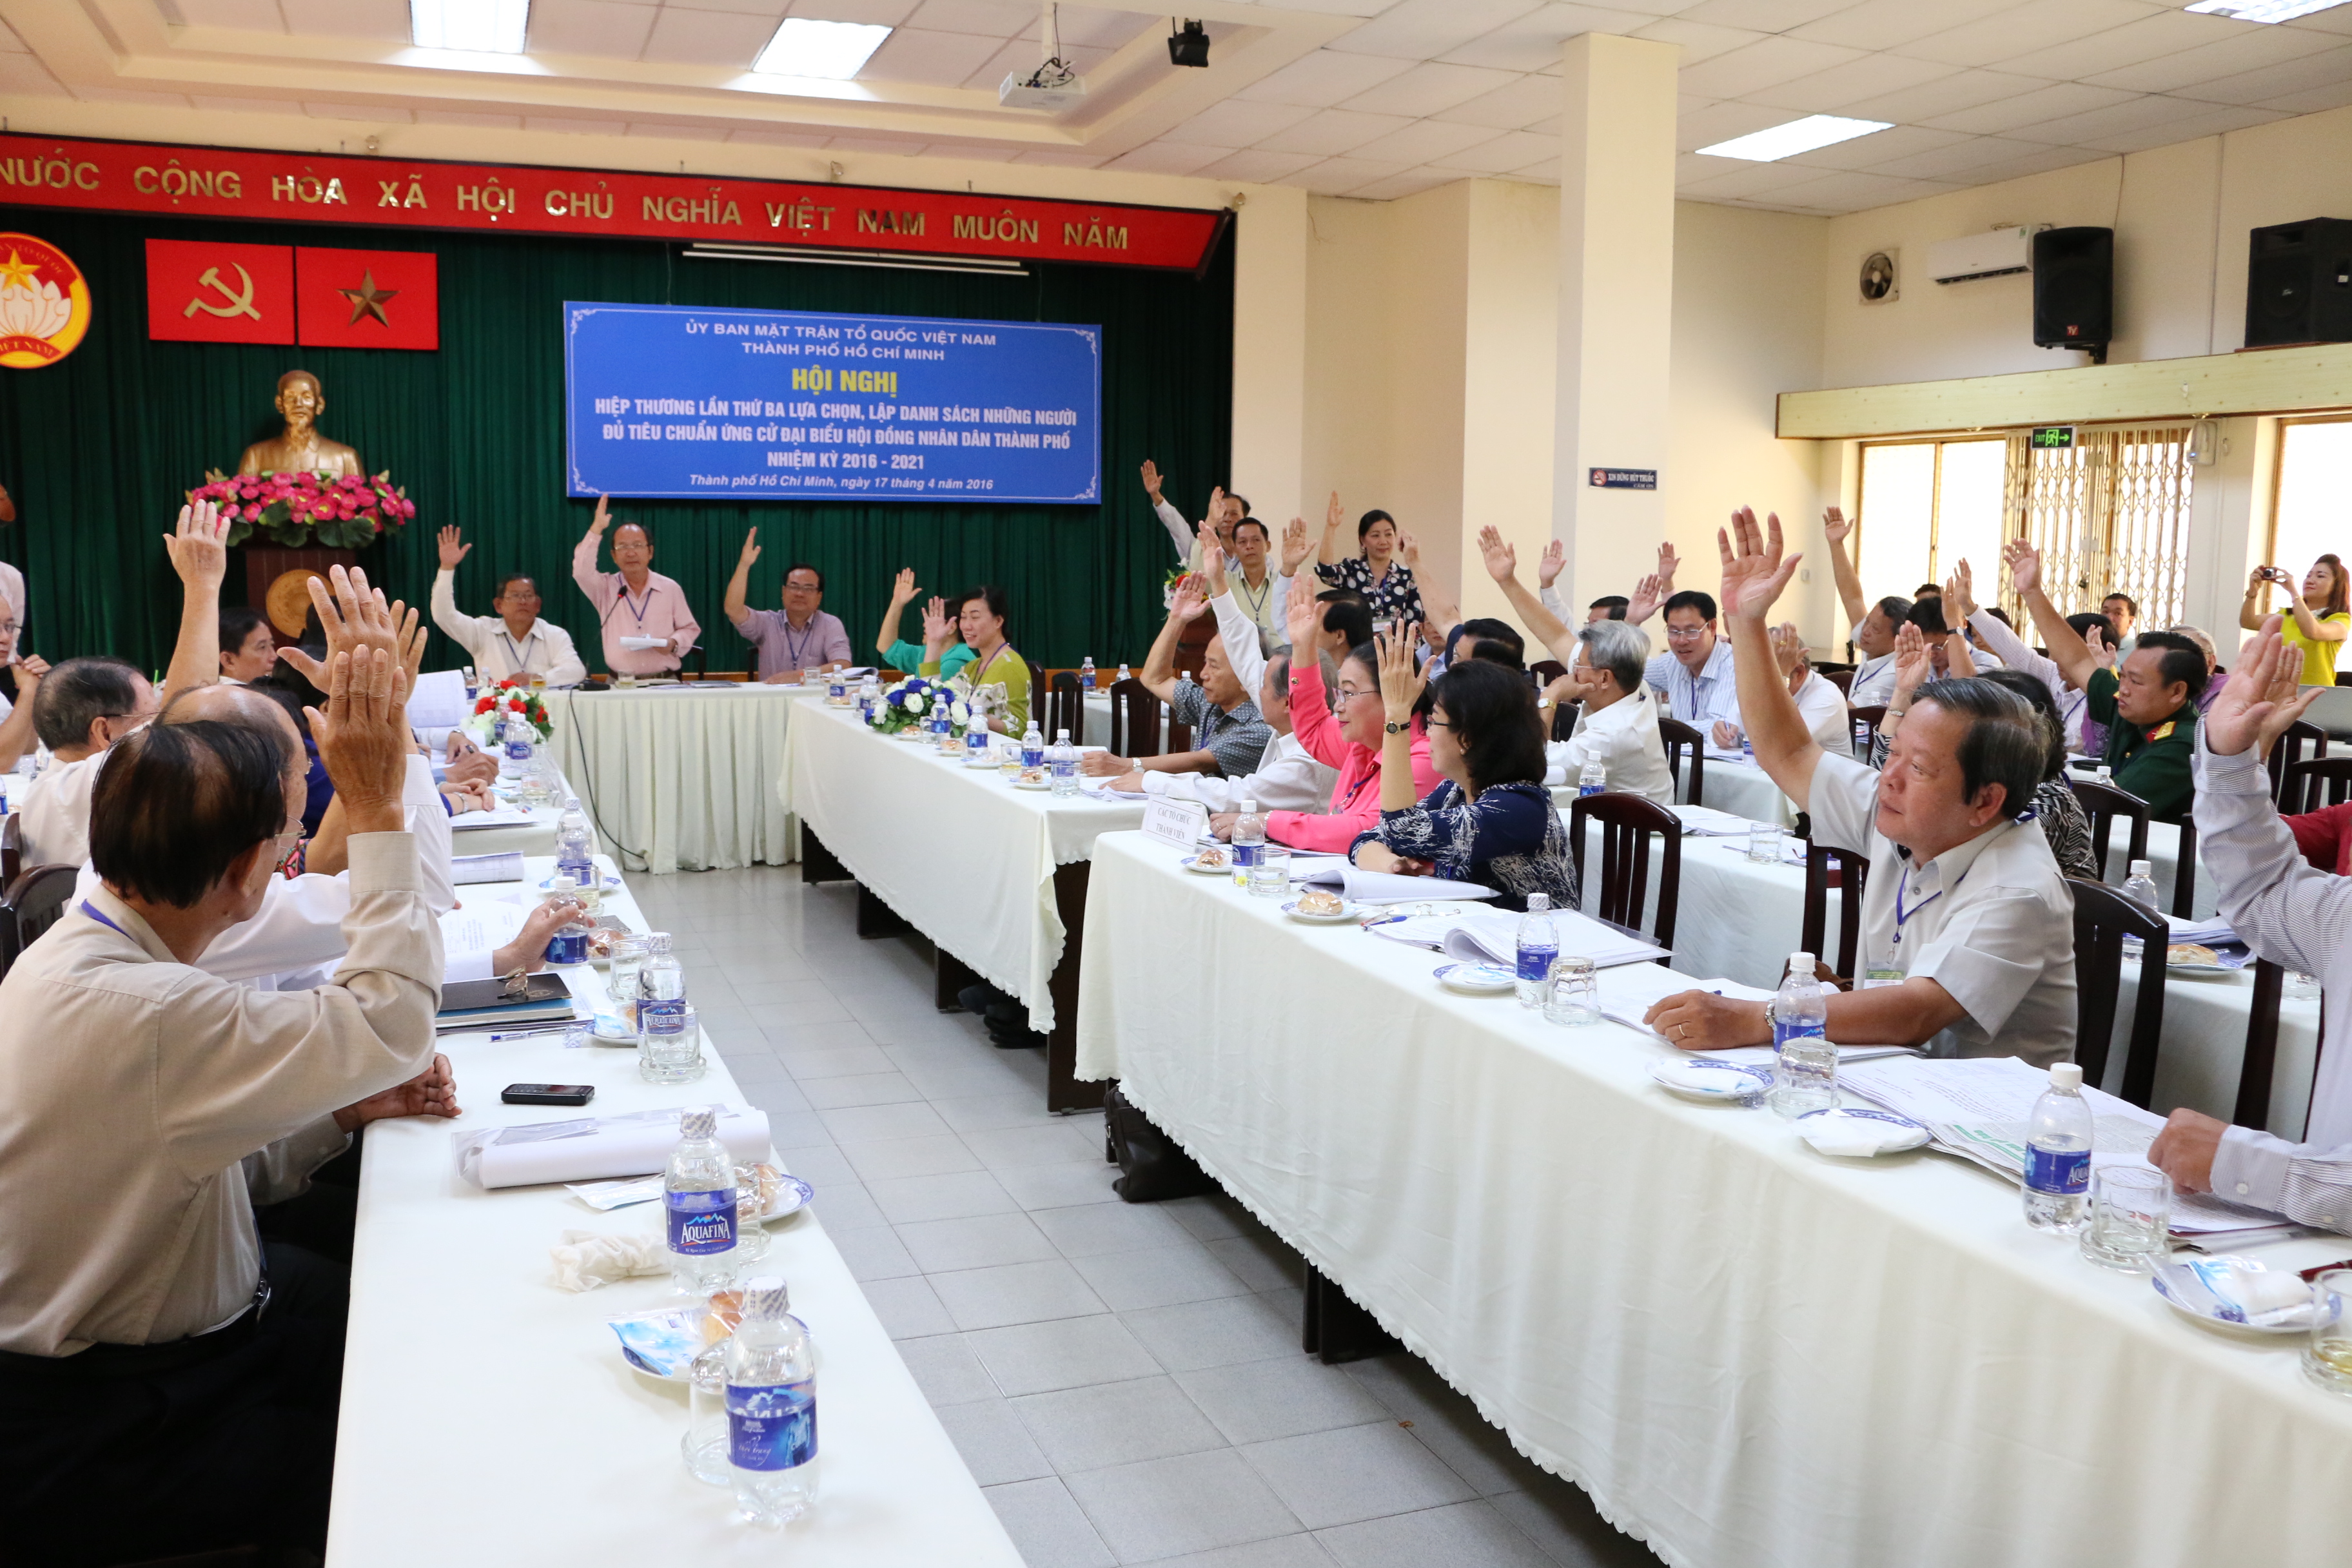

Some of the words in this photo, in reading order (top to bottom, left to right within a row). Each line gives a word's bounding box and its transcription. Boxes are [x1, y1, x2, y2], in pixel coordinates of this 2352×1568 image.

[0, 149, 99, 189] NƯỚC
[135, 159, 240, 204] CỘNG
[273, 168, 348, 204] HÒA
[378, 175, 427, 208] XÃ
[458, 177, 514, 221] HỘI
[545, 182, 613, 219] CHỦ
[643, 188, 741, 224] NGHĨA
[766, 198, 834, 236] VIỆT
[859, 210, 924, 235] NAM
[954, 210, 1037, 242] MUÔN
[1065, 219, 1127, 249] NĂM
[686, 319, 708, 333] ỦY
[714, 324, 749, 335] BAN
[755, 324, 789, 338] MẶT
[794, 325, 839, 339] TRẬN
[845, 324, 866, 339] TỔ
[871, 328, 916, 342] QUỐC
[923, 331, 957, 344] VIỆT
[963, 334, 995, 344] NAM
[742, 341, 799, 354] THÀNH
[805, 342, 839, 356] PHỐ
[845, 344, 868, 357] HỒ
[872, 346, 899, 358] CHÍ
[905, 349, 944, 360] MINH
[792, 365, 832, 395] HỘI
[841, 370, 896, 397] NGHỊ
[595, 396, 631, 417] HIỆP
[634, 398, 695, 415] THƯƠNG
[700, 396, 729, 415] LẦN
[732, 398, 763, 416] THỨ
[765, 402, 785, 416] BA
[789, 402, 817, 420] LỰA
[821, 404, 865, 422] CHỌN,
[869, 402, 896, 422] LẬP
[900, 406, 938, 421] DANH
[943, 405, 979, 422] SÁCH
[984, 407, 1031, 424] NHỮNG
[1035, 409, 1076, 425] NGƯỜI
[603, 420, 624, 440] ĐỦ
[628, 422, 661, 440] TIÊU
[665, 420, 717, 440] CHUẨN
[721, 424, 752, 441] ỨNG
[757, 422, 778, 442] CỬ
[781, 427, 805, 445] ĐẠI
[810, 423, 843, 443] BIỂU
[847, 426, 871, 446] HỘI
[875, 426, 914, 444] ĐỒNG
[919, 428, 957, 446] NHÂN
[962, 429, 990, 446] DÂN
[994, 431, 1039, 447] THÀNH
[1043, 431, 1070, 449] PHỐ
[2035, 434, 2045, 443] EXIT
[768, 449, 815, 469] NHIỆM
[820, 451, 838, 467] KỲ
[843, 453, 877, 468] 2016
[891, 455, 923, 469] 2021
[691, 475, 729, 485] Thành
[732, 475, 757, 487] phố
[760, 475, 777, 485] Hồ
[780, 476, 801, 485] Chí
[805, 476, 836, 487] Minh,
[841, 477, 870, 489] ngày
[876, 478, 888, 487] 17
[891, 478, 925, 490] tháng
[928, 479, 934, 487] 4
[939, 479, 963, 488] năm
[966, 480, 993, 489] 2016
[1157, 806, 1169, 818] CÁC
[1176, 813, 1191, 825] CHỨC
[1156, 823, 1173, 836] THÀNH
[1173, 828, 1186, 840] VIÊN
[681, 1220, 731, 1244] AQUAFINA
